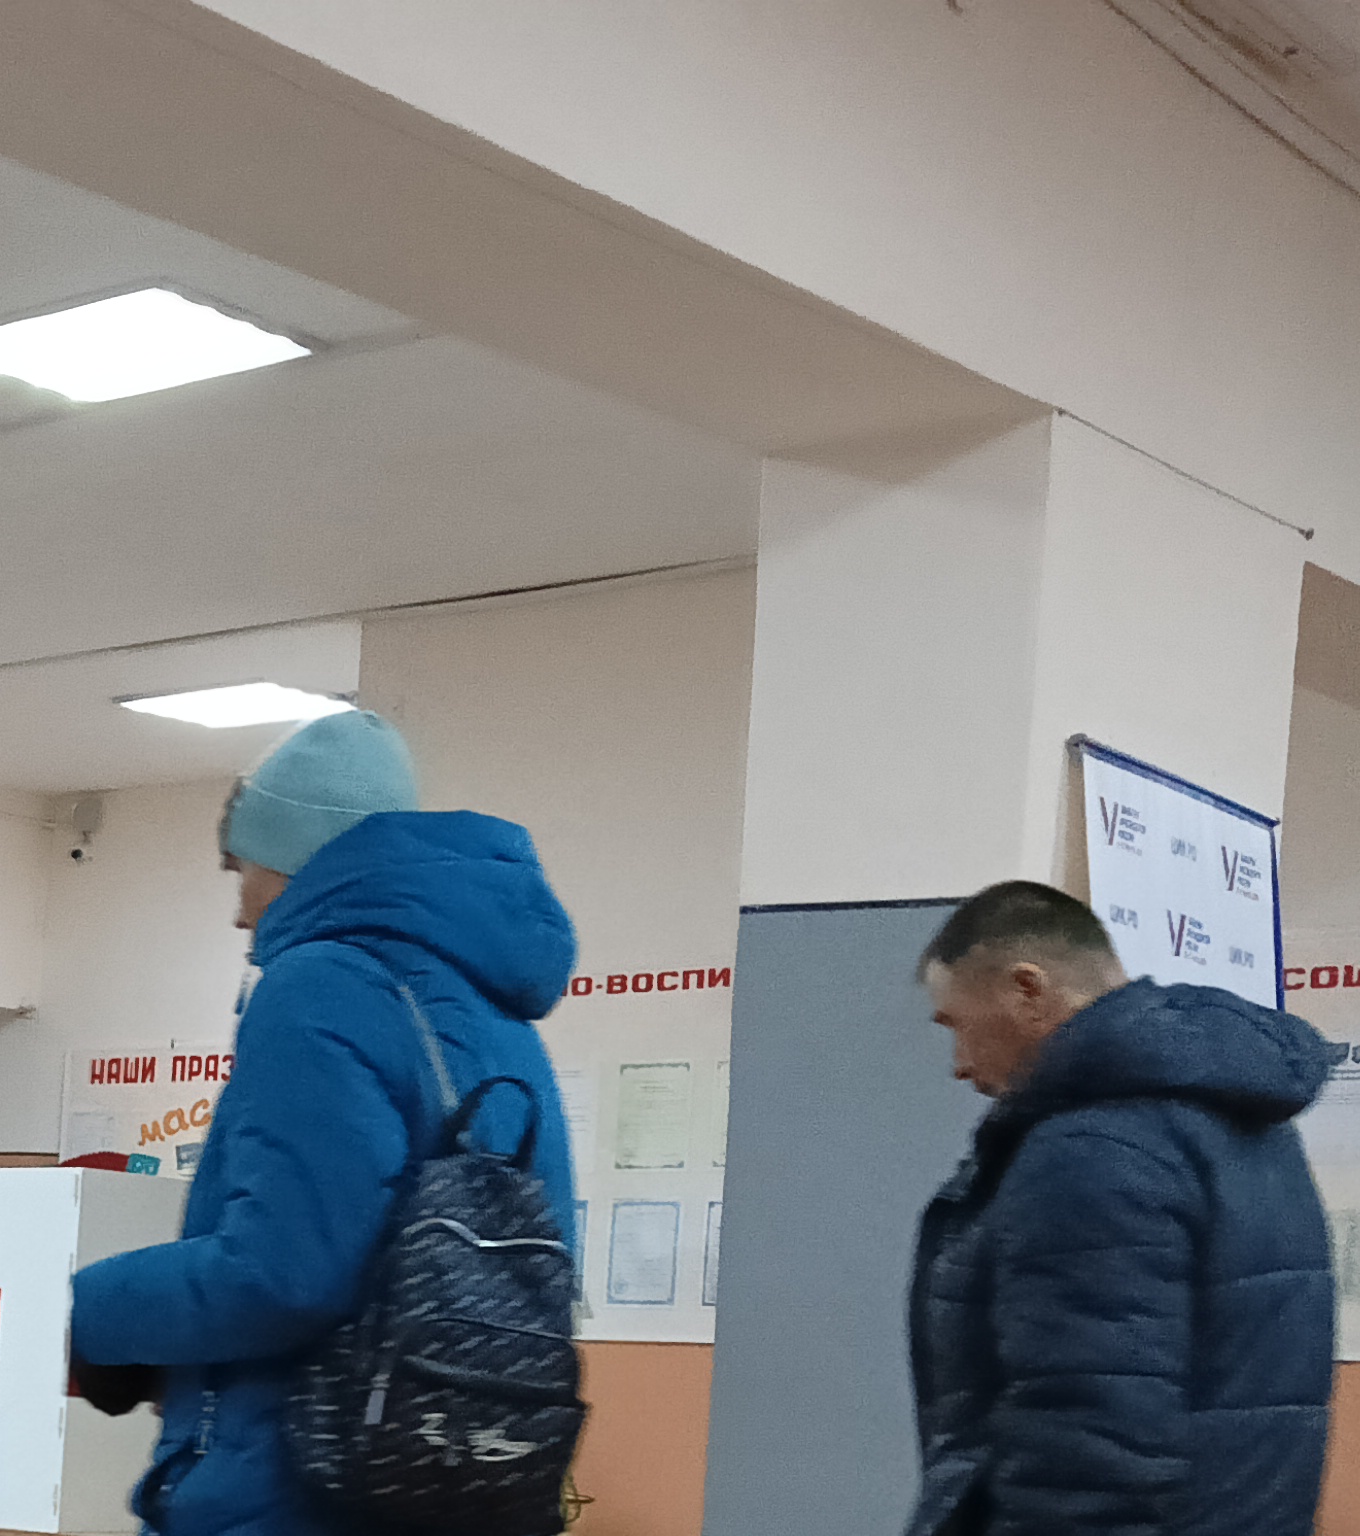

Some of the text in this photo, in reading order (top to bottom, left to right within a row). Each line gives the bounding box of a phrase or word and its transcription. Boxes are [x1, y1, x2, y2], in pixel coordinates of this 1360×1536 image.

[562, 966, 732, 997] О-ВОСПИ
[90, 1054, 236, 1085] НАШИ ПРАЗ
